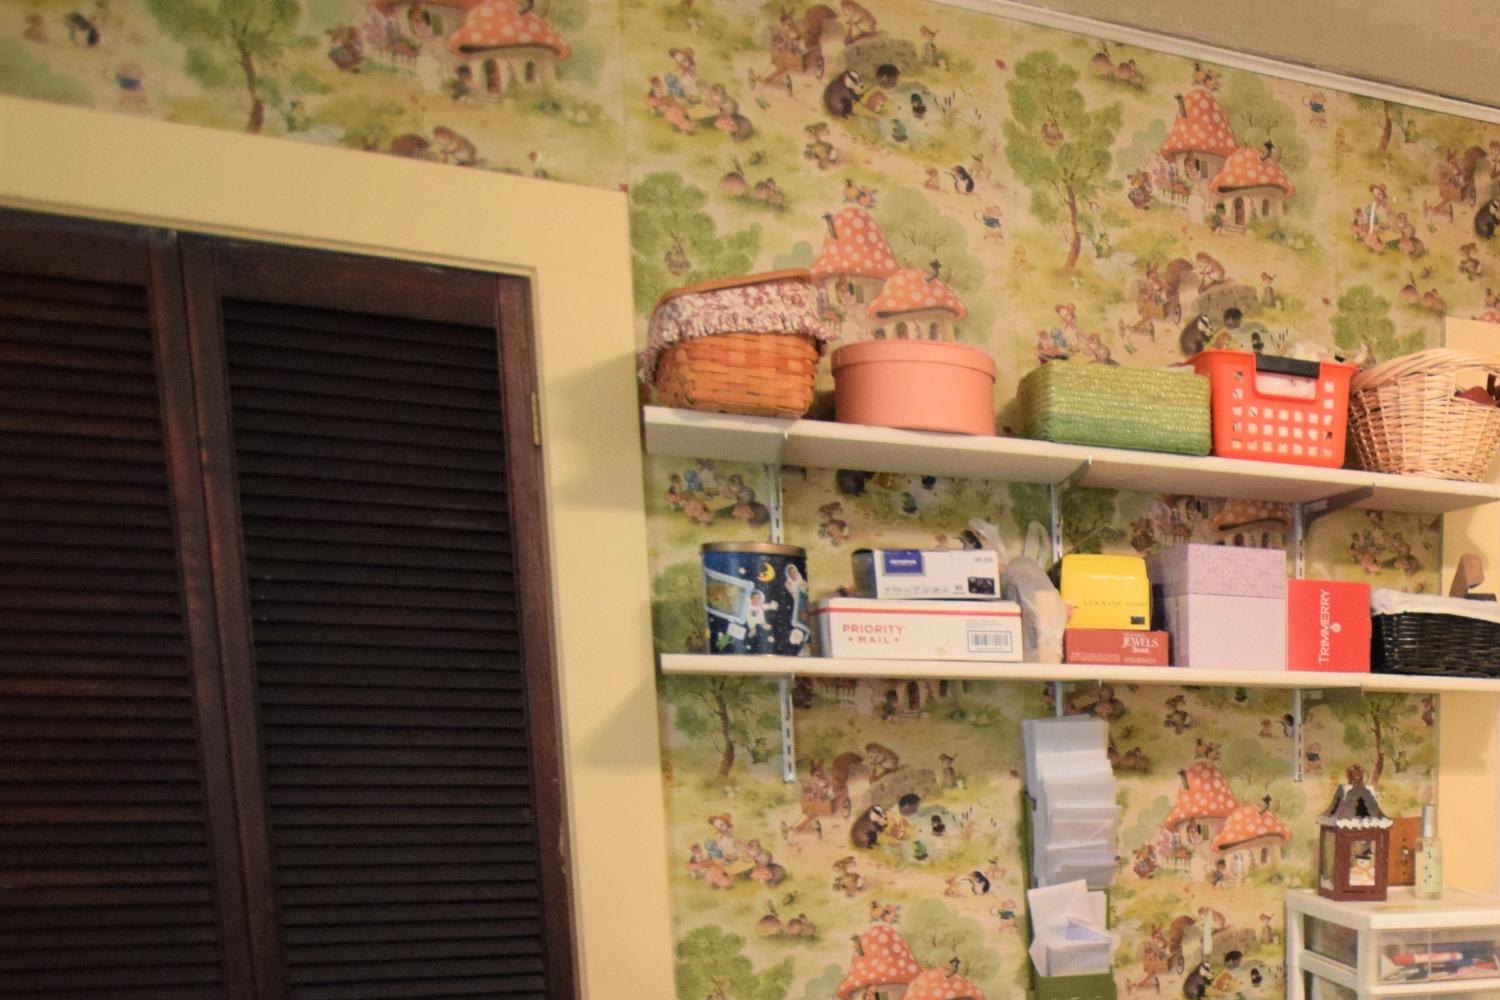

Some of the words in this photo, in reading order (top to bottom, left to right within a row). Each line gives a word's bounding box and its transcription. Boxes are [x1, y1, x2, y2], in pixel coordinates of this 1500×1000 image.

[842, 623, 904, 635] PRIORITY
[857, 635, 890, 645] MAIL
[1122, 635, 1160, 648] JEWELS
